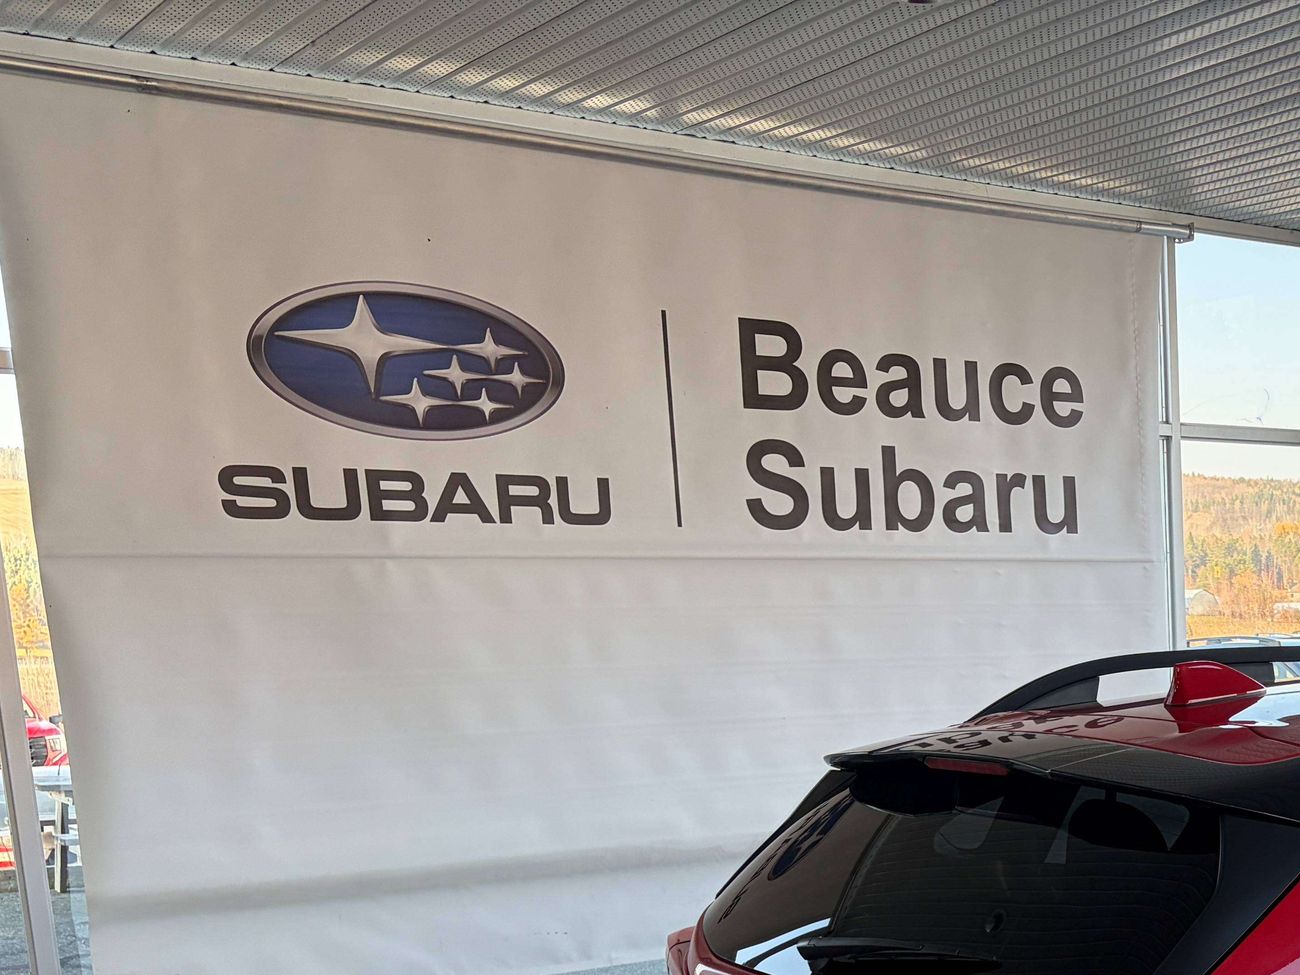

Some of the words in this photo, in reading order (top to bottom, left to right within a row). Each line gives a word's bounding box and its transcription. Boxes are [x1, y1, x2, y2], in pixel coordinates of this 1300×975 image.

[738, 317, 1084, 429] Beauce
[217, 464, 612, 526] SUBARU
[746, 438, 1079, 535] Subaru
